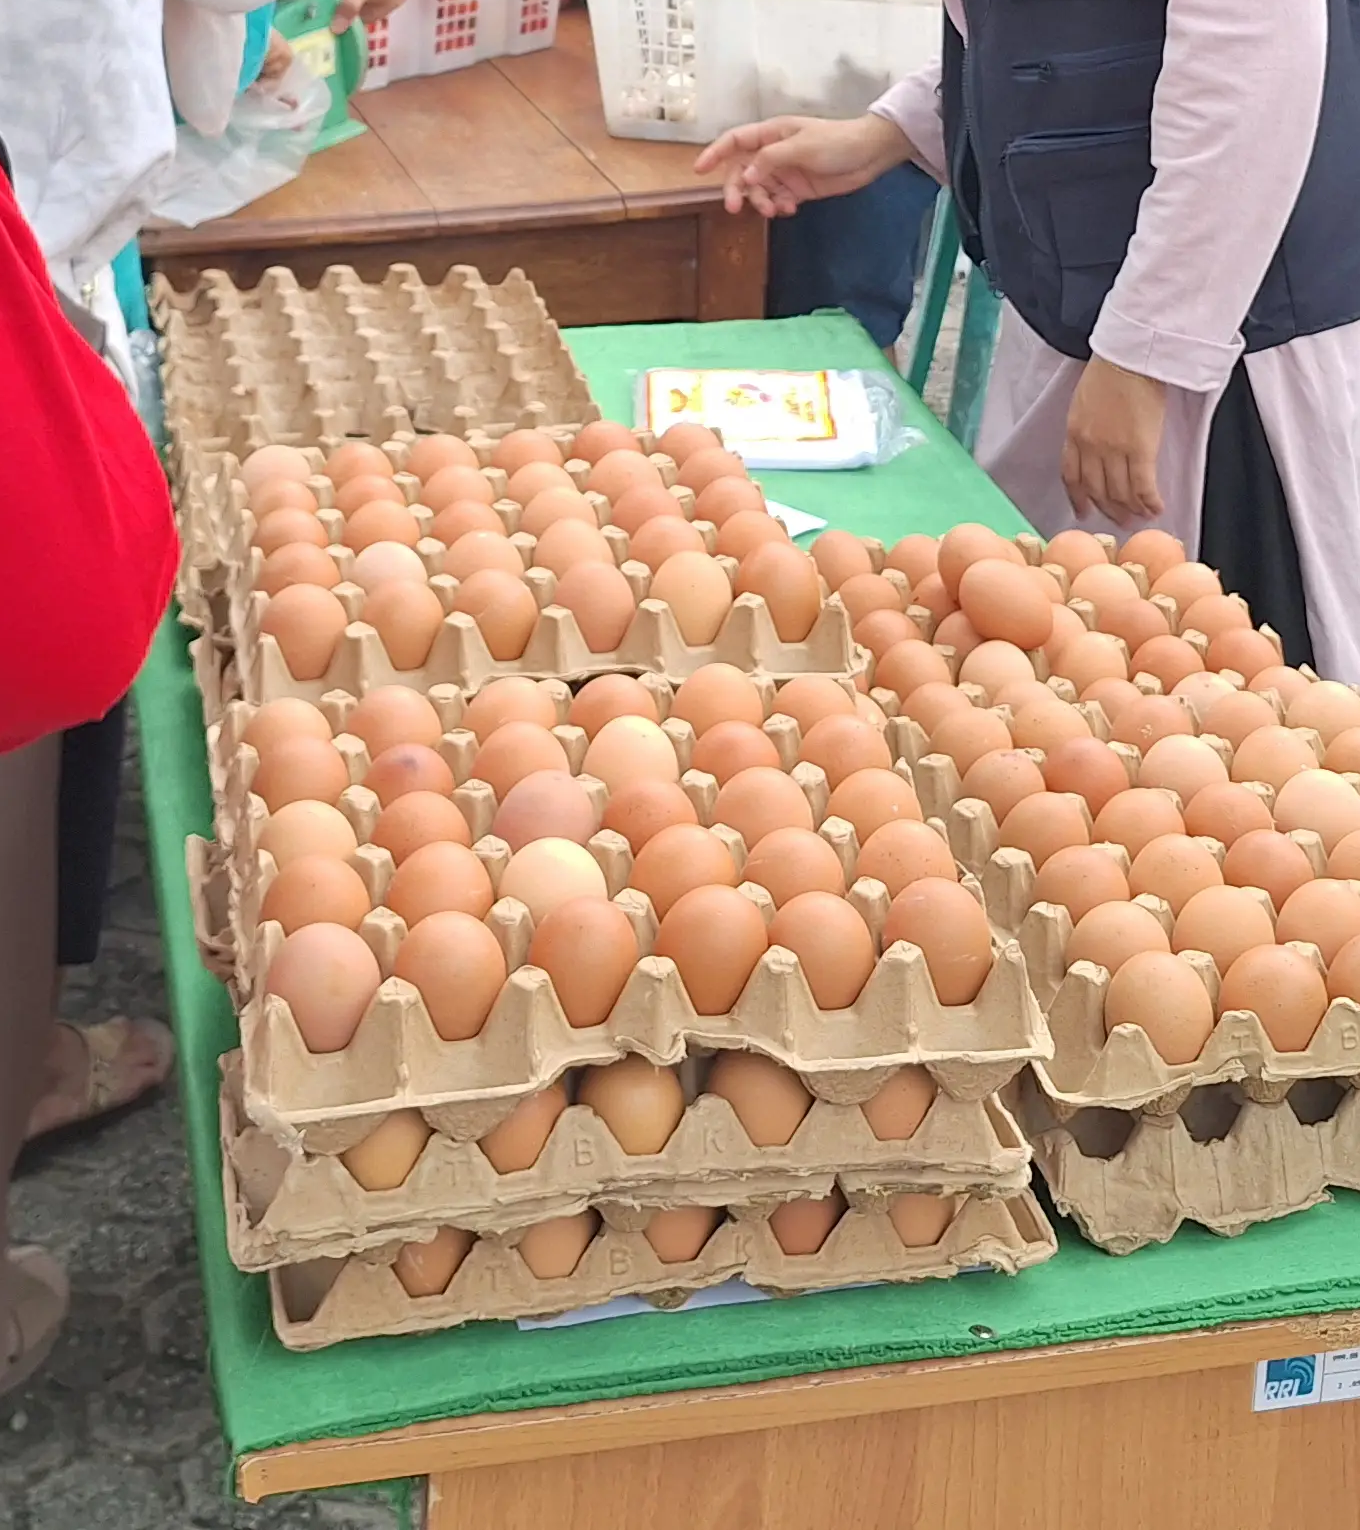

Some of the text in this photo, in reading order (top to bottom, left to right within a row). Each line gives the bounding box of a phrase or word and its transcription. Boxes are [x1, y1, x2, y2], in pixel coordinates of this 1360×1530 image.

[1341, 1022, 1358, 1050] B
[573, 1137, 595, 1167] B
[701, 1127, 727, 1154] K
[608, 1248, 634, 1276] B
[1264, 1378, 1301, 1401] RRI
